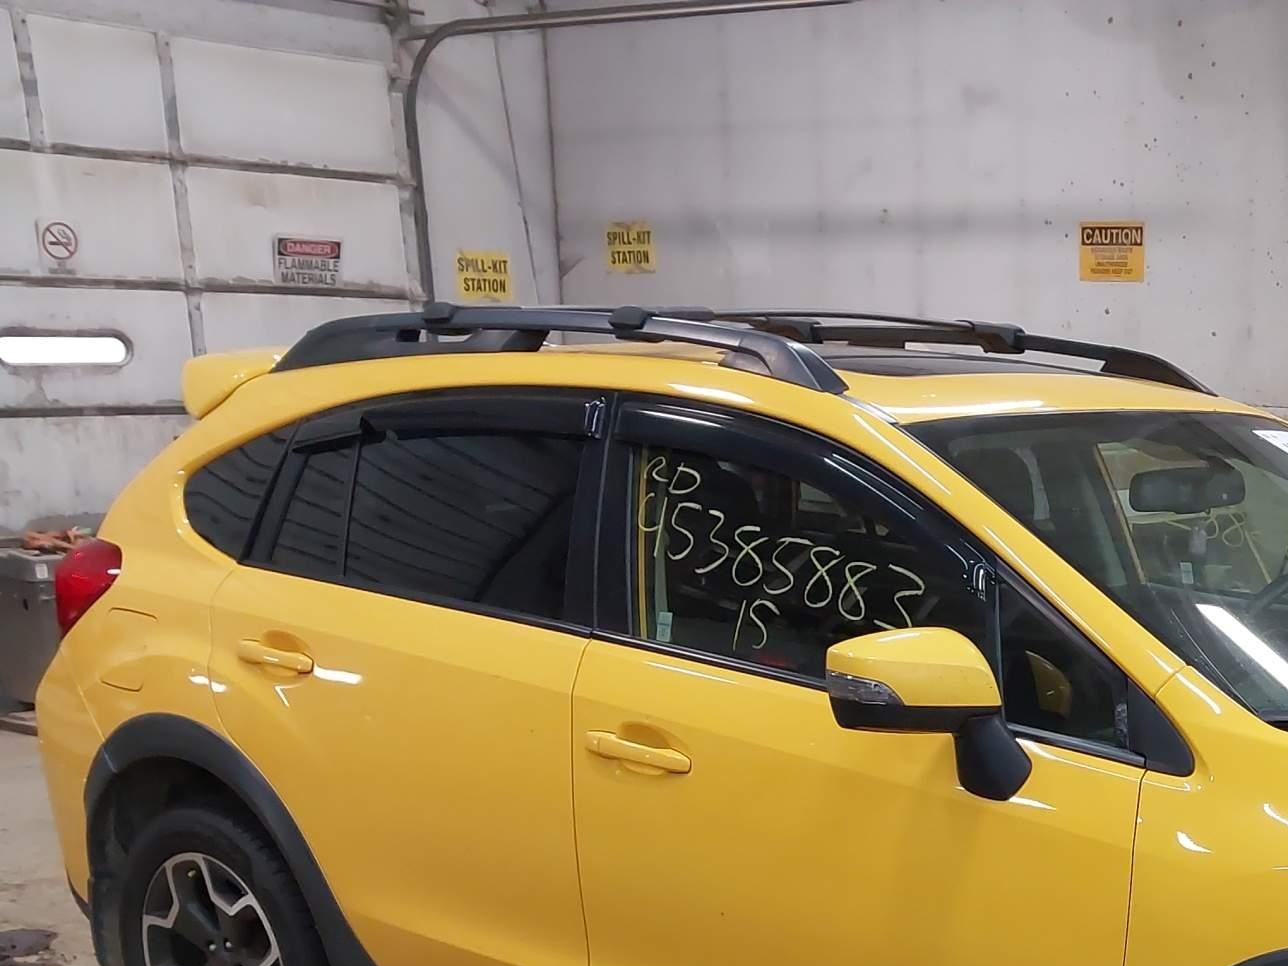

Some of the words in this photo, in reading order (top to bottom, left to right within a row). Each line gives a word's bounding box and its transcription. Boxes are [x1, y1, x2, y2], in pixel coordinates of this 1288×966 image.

[607, 231, 651, 246] SPILL-KIT
[1083, 229, 1141, 244] CAUTION
[286, 242, 332, 254] DANGER
[278, 257, 340, 272] FLAMMABLE
[611, 250, 649, 264] STATION
[457, 257, 508, 273] SPILL-KIT
[281, 271, 337, 286] MATERIALS
[463, 277, 506, 293] STATION
[638, 493, 925, 629] 45385883
